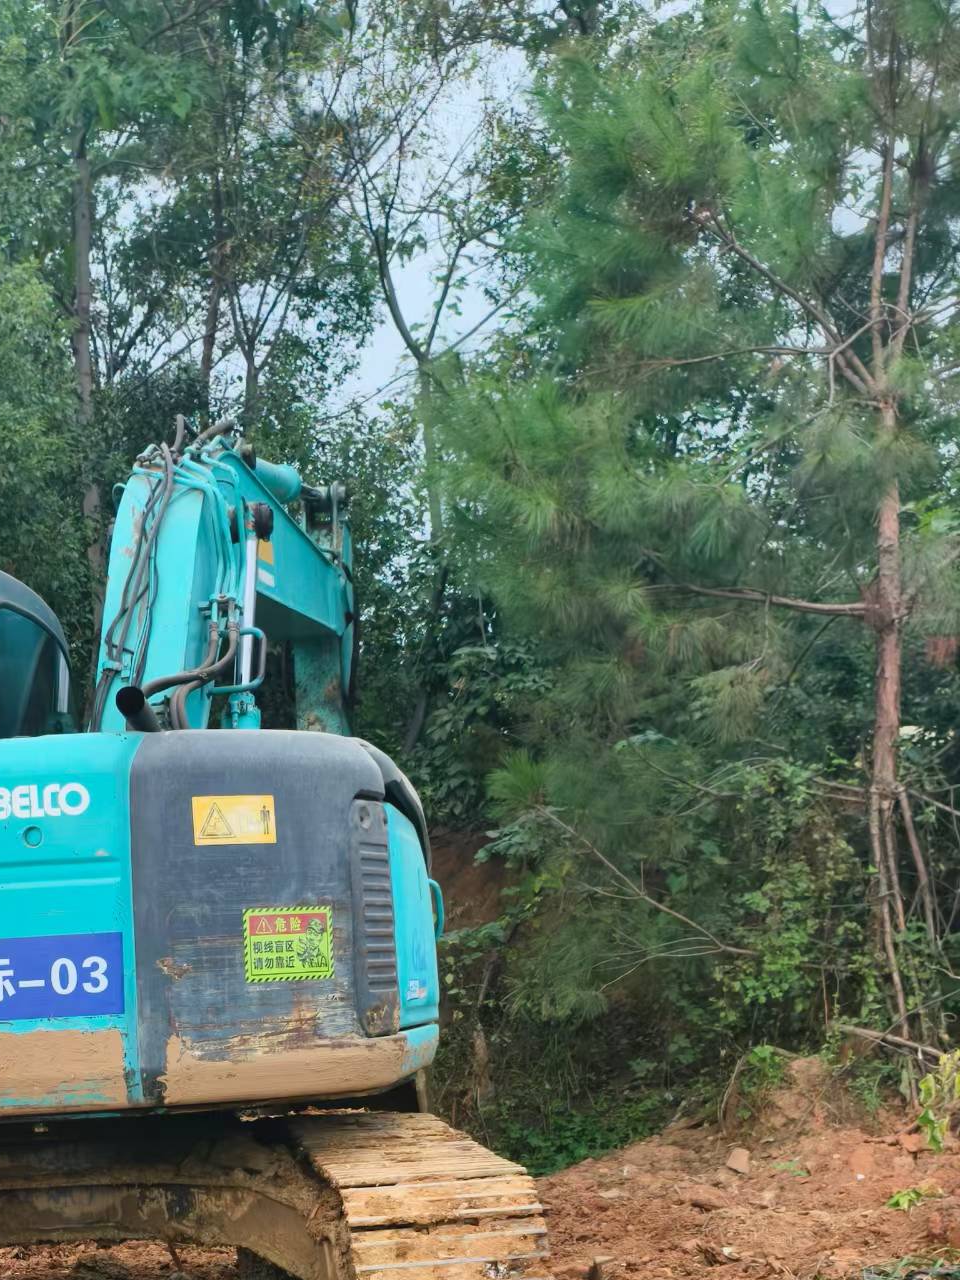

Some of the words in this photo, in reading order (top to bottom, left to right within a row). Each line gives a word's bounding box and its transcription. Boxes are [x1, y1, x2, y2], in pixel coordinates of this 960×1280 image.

[275, 916, 302, 933] 危险
[253, 955, 296, 970] 请勿靠近
